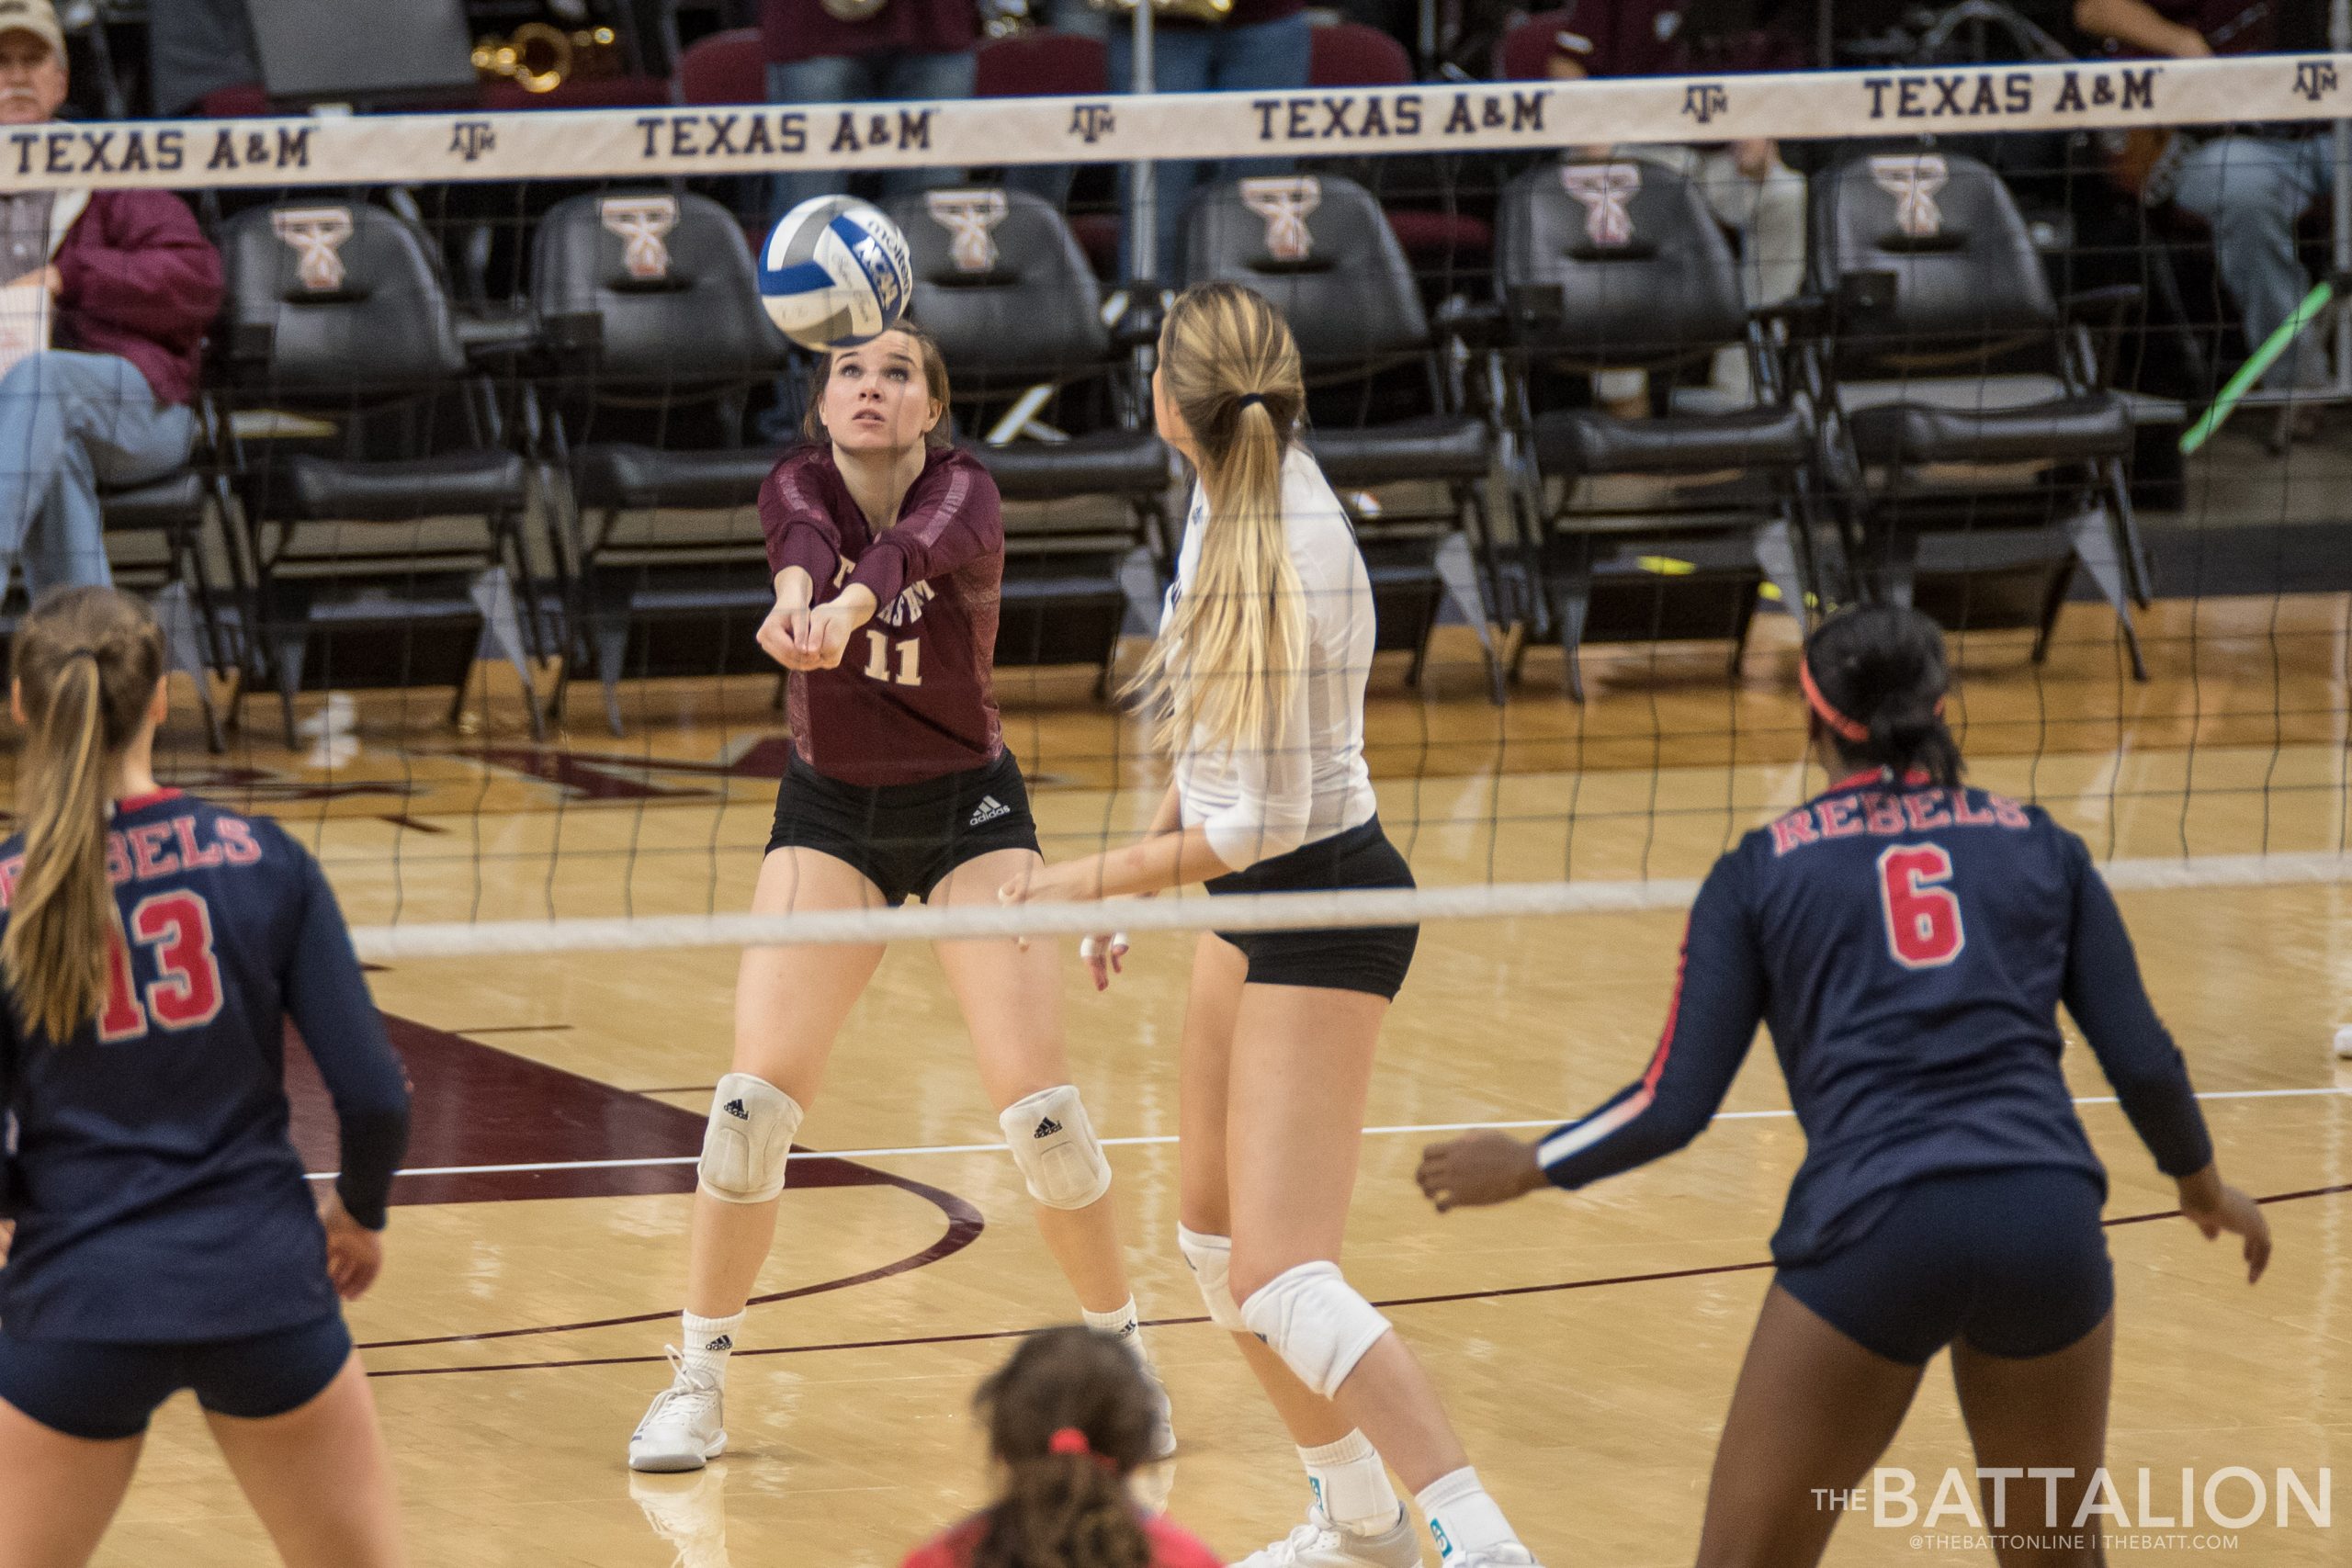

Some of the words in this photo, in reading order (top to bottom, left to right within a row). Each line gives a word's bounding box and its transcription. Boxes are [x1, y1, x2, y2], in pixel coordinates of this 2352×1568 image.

[1253, 96, 1422, 140] TEXAS
[1444, 91, 1545, 134] A&M
[1864, 74, 2033, 118] TEXAS
[2053, 68, 2155, 113] A&M
[11, 130, 184, 175] TEXAS
[207, 127, 311, 170] A&M
[637, 112, 807, 158] TEXAS
[830, 110, 933, 152] A&M
[852, 235, 899, 311] NCAA
[864, 629, 922, 687] 11
[969, 805, 1011, 826] adidas
[1770, 790, 2030, 855] REBELS
[1878, 842, 1964, 969] 6
[98, 889, 223, 1042] 13
